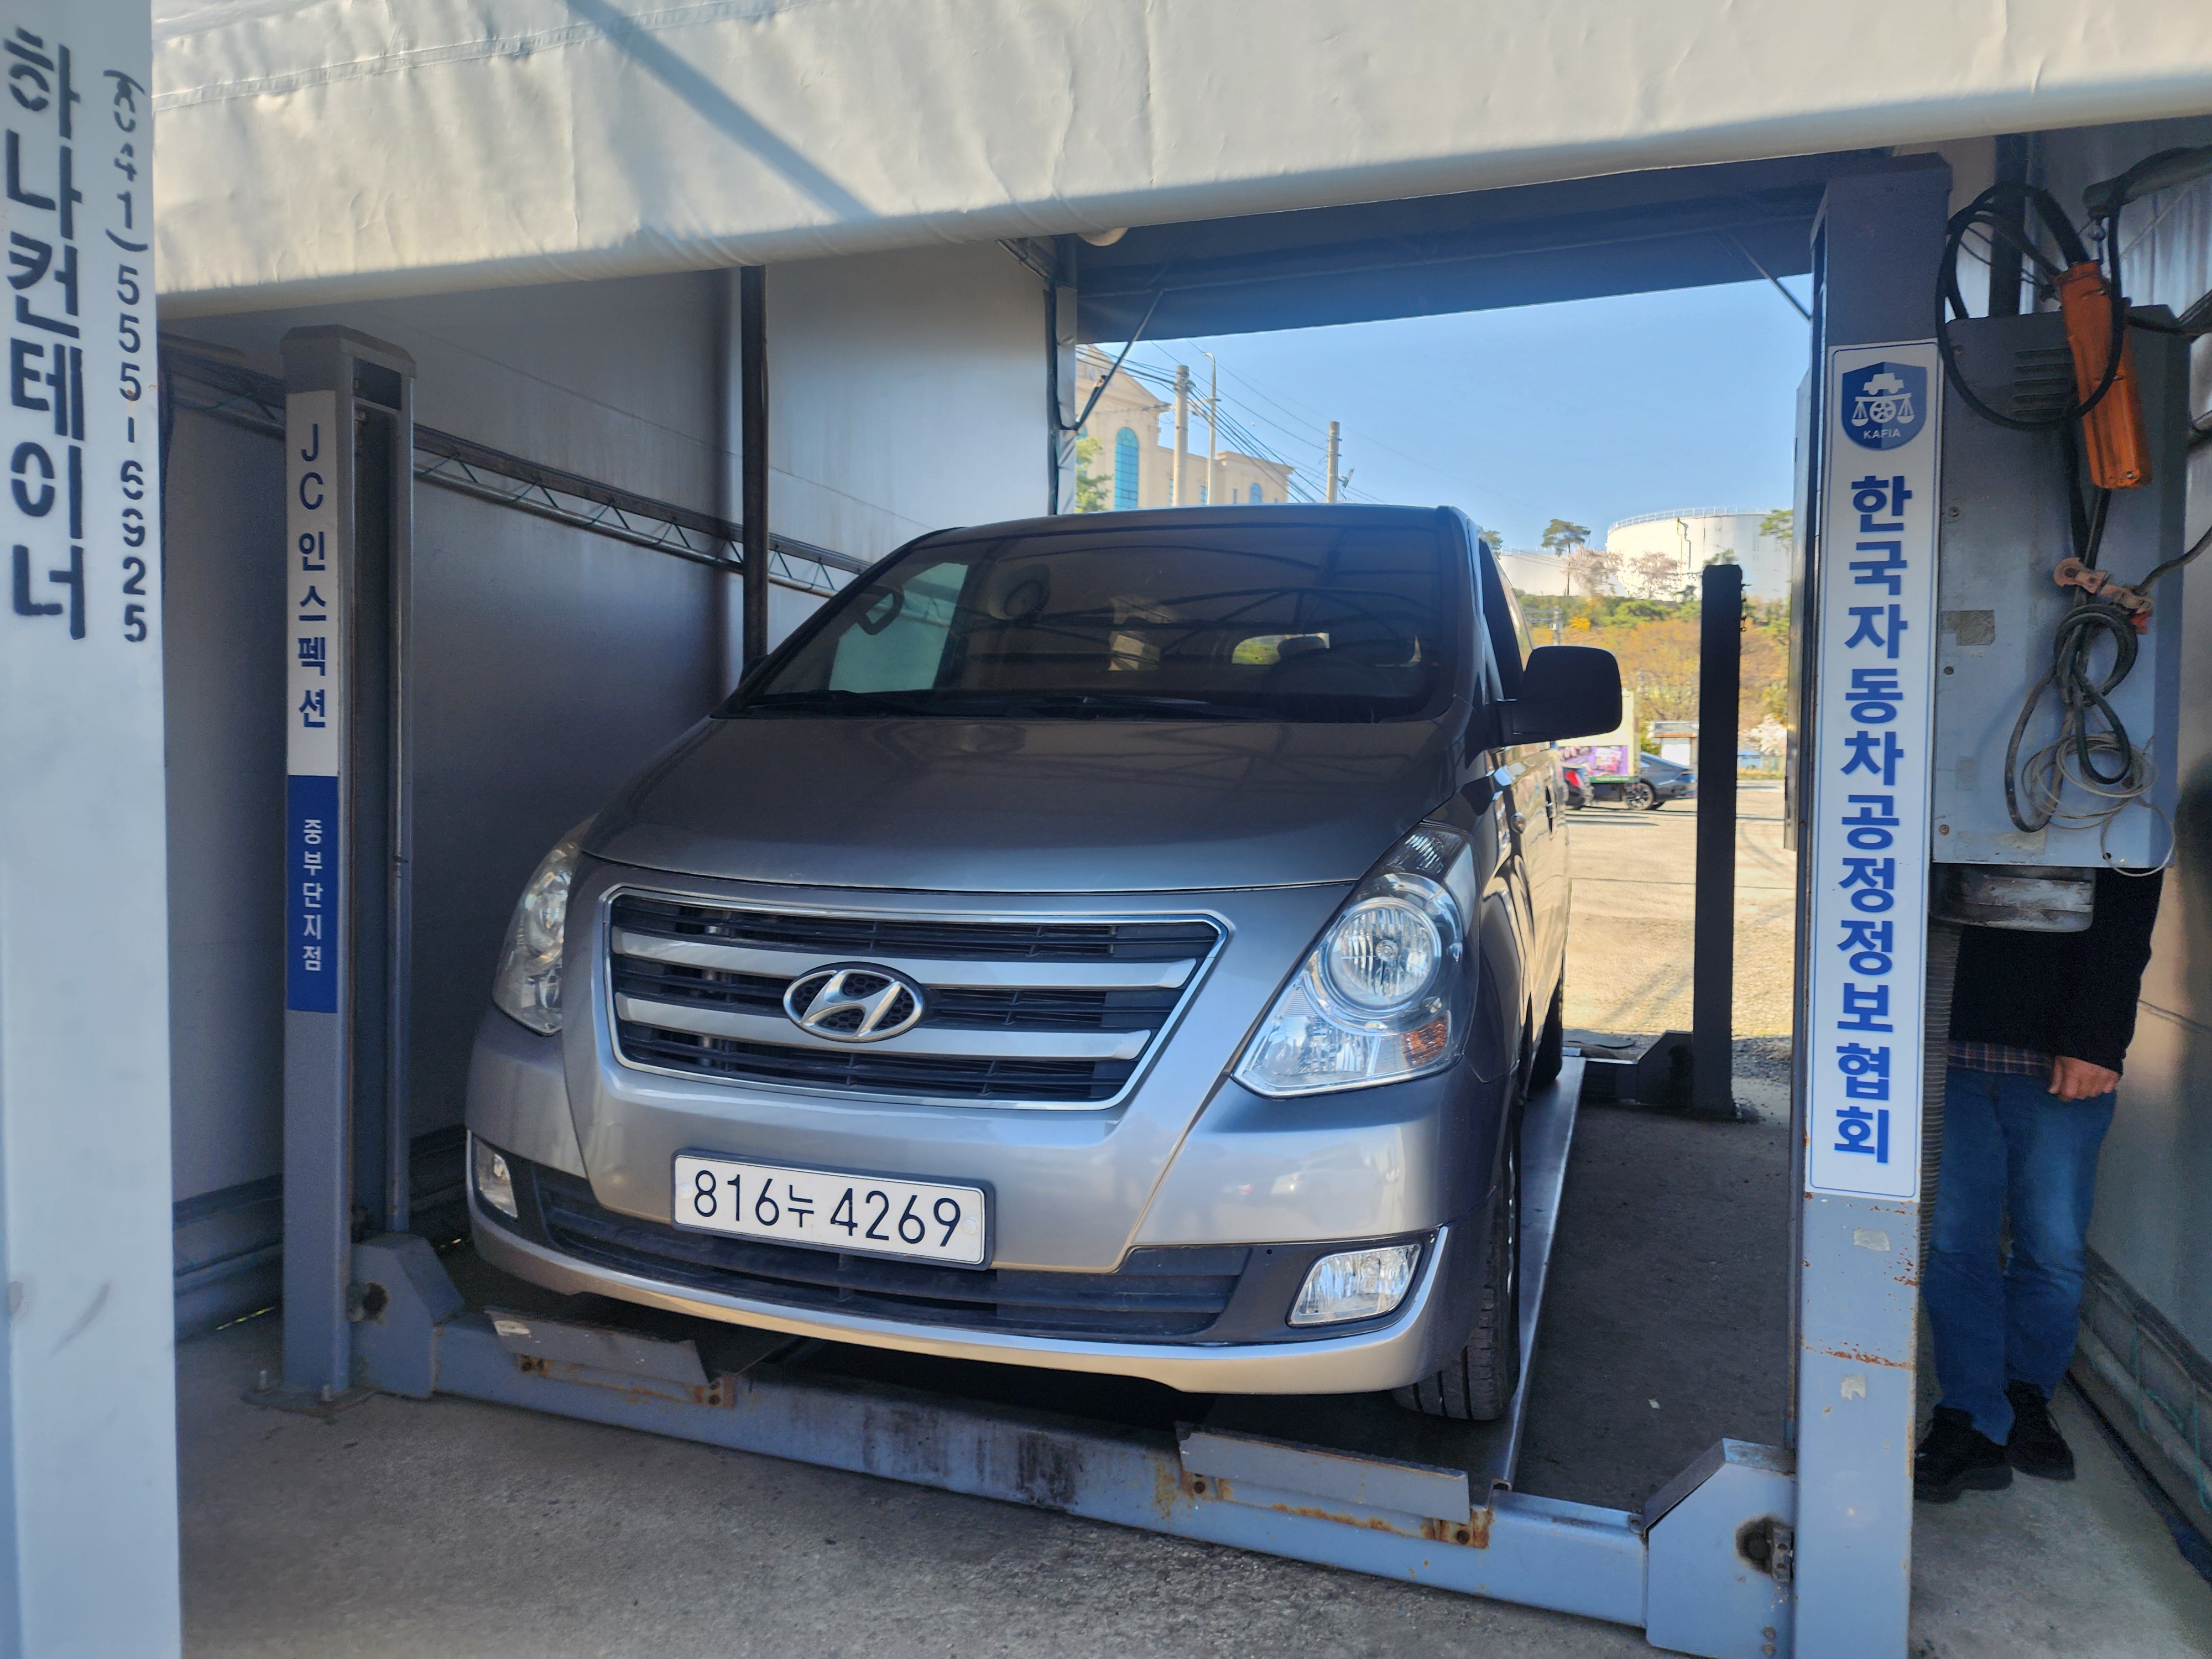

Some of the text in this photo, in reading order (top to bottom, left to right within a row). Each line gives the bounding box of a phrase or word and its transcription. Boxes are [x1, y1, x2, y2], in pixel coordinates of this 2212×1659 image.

[4, 26, 85, 639] 하나컨테이너
[1863, 429, 1901, 439] KAFIA
[298, 423, 327, 729] JC 인스펙션
[302, 818, 324, 973] 중부단지점
[1834, 475, 1912, 1163] 한국자동차공정정보협회
